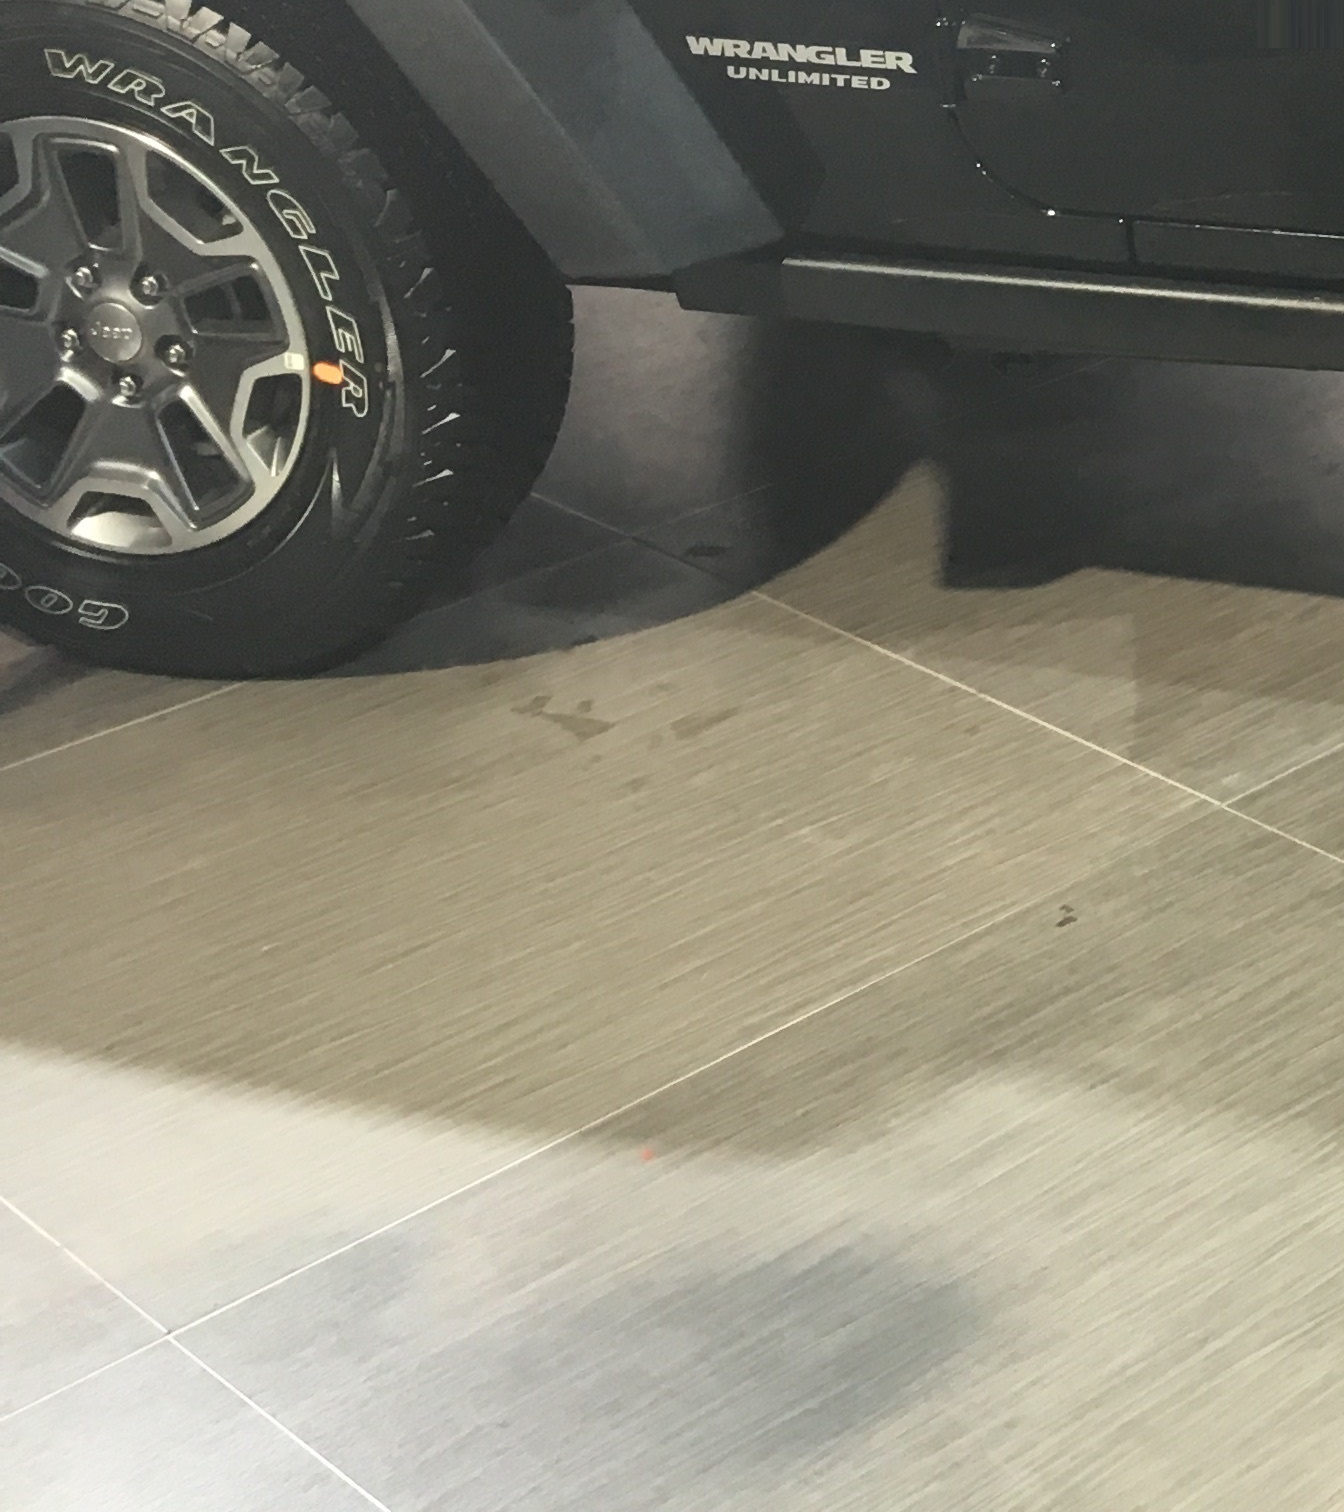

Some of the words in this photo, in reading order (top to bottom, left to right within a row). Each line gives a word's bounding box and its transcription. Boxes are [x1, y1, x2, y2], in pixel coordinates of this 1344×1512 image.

[685, 35, 918, 74] WRANGLER
[726, 65, 891, 91] UNLIMITED
[43, 48, 371, 418] WRANGLER
[90, 320, 133, 341] Jeep
